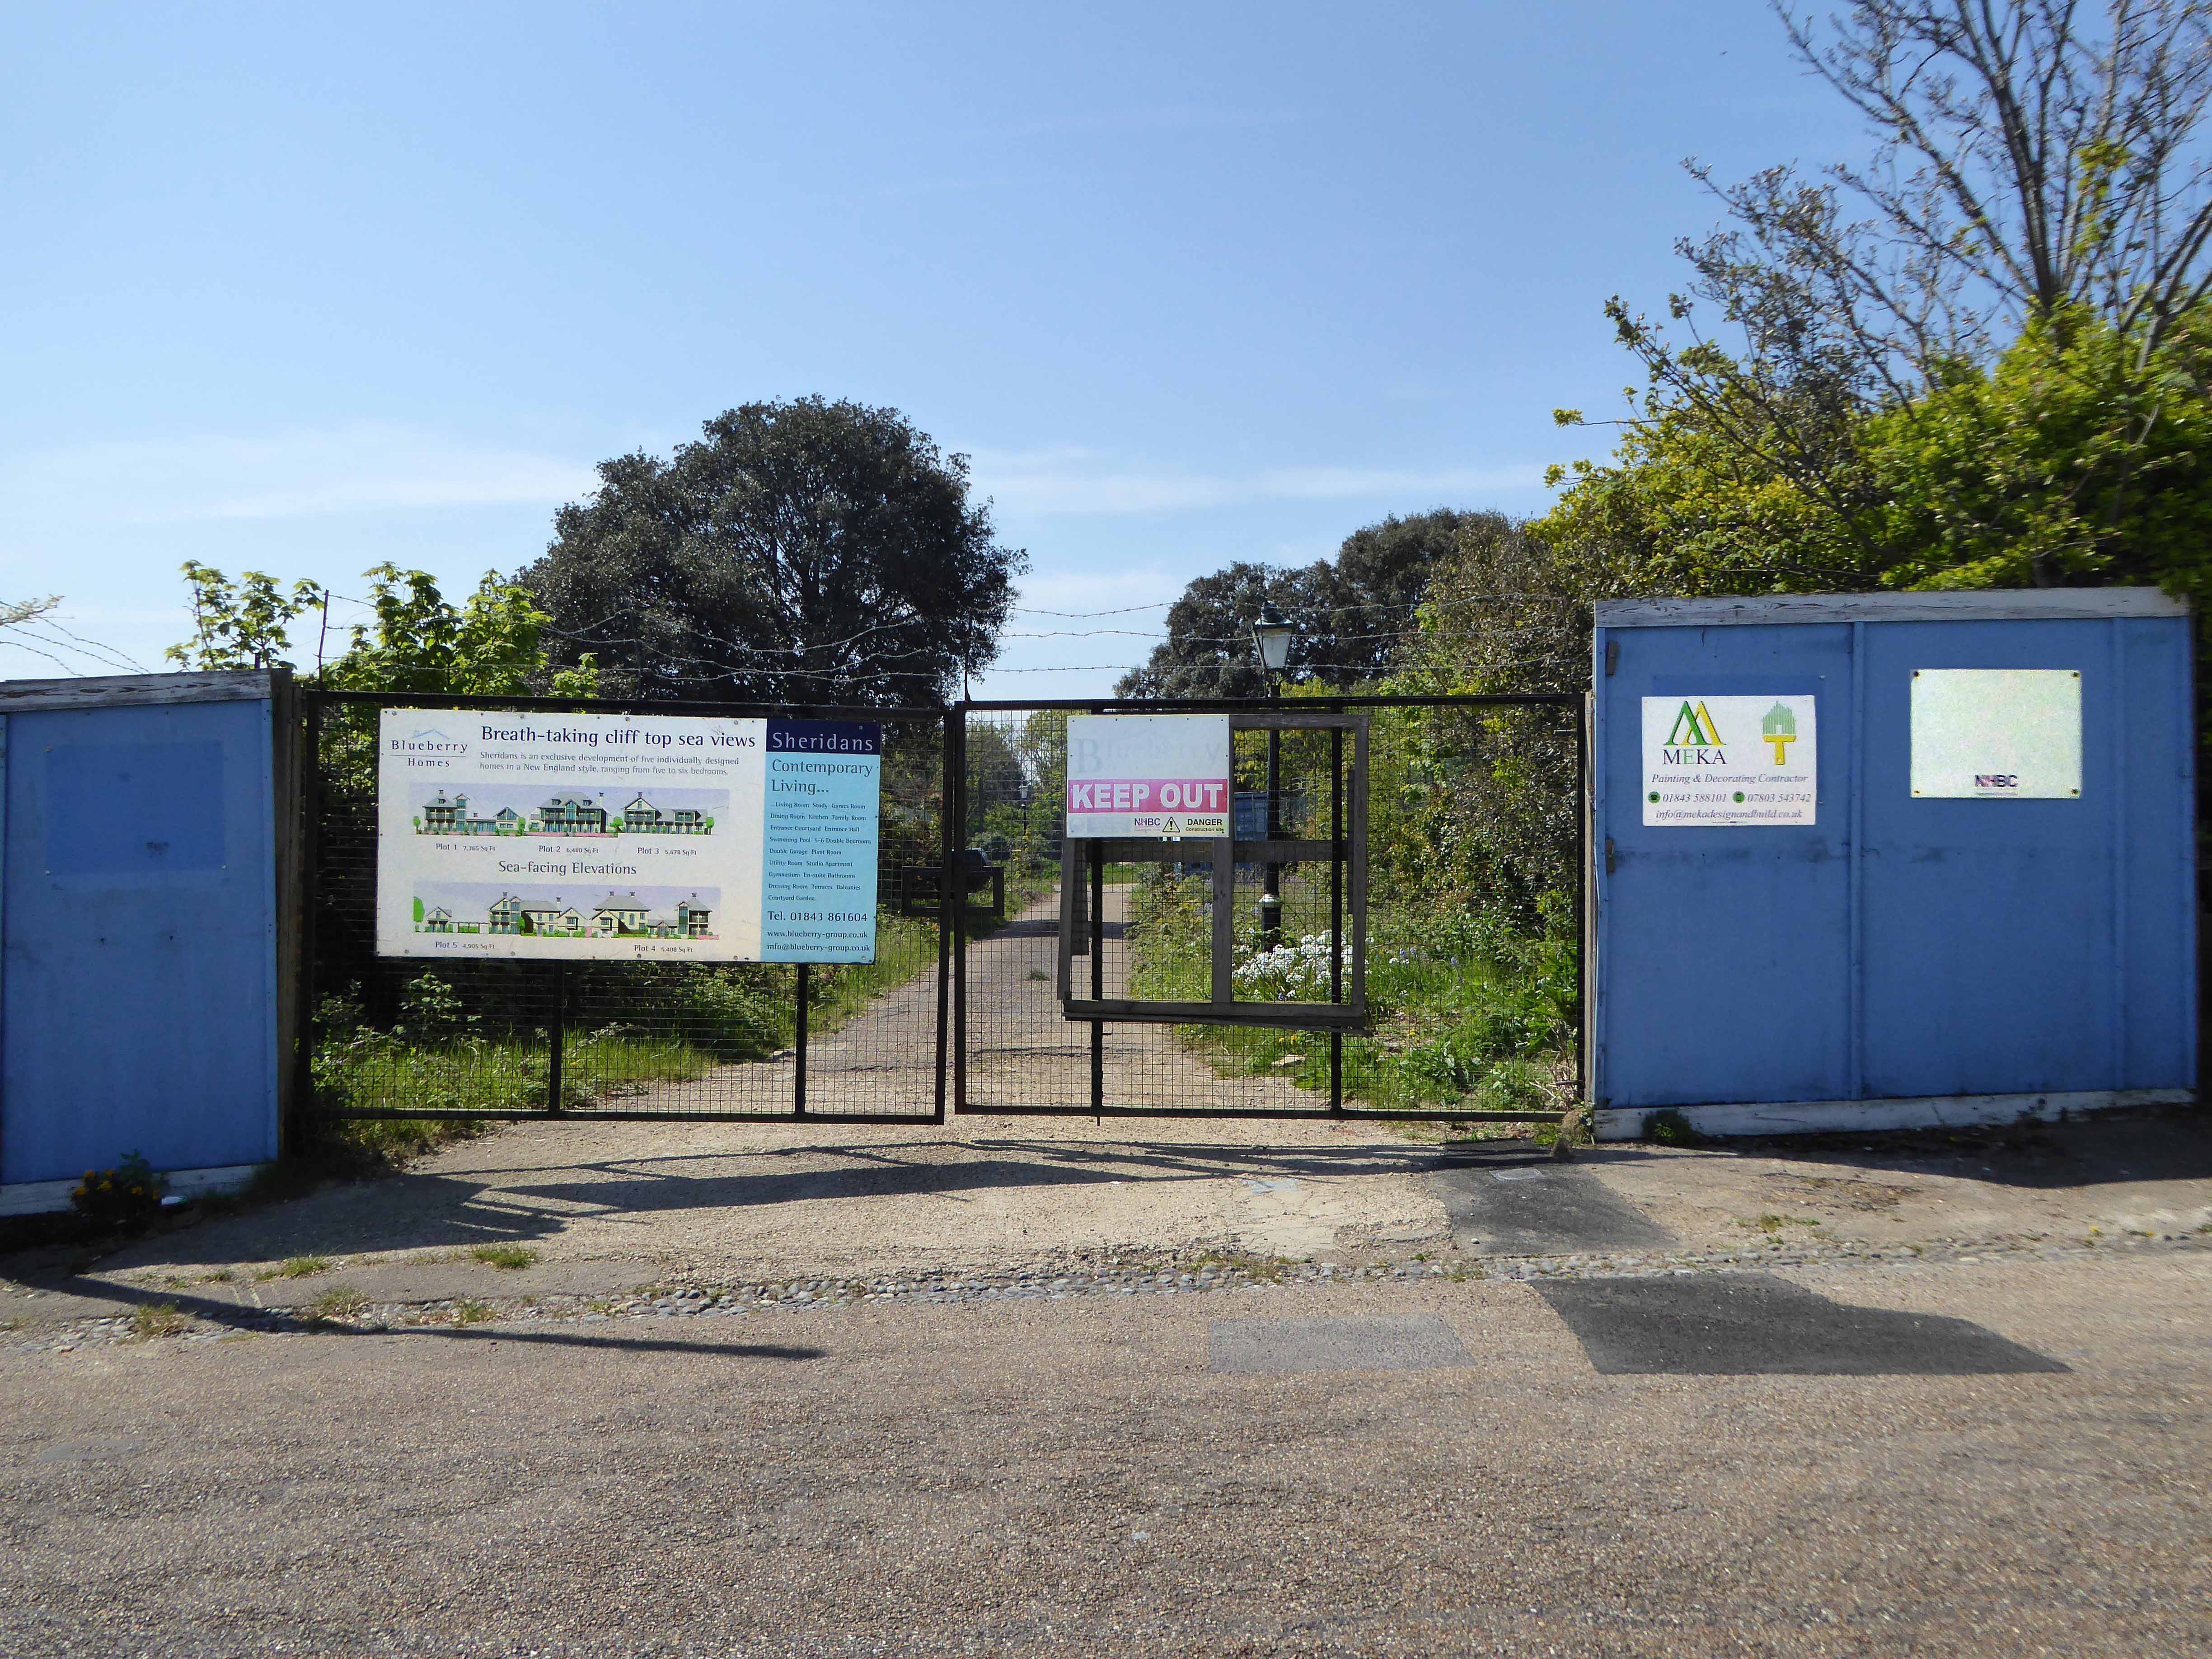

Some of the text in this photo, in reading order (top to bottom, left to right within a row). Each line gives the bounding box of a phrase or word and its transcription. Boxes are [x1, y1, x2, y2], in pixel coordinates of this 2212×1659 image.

[482, 726, 755, 748] Breath-taking cliff top sea views
[772, 732, 873, 751] Sheridans
[392, 740, 468, 753] Blueberry
[408, 758, 450, 767] Homes
[480, 751, 518, 759] Sheridans
[578, 754, 628, 763] development
[657, 755, 702, 765] individually
[705, 757, 739, 766] designed
[1663, 749, 1728, 765] MEKA
[544, 764, 575, 772] England
[578, 764, 599, 773] style,
[653, 766, 665, 774] five
[772, 759, 873, 777] Contemporary
[1651, 773, 1809, 784] Painting & Decorating Contractor
[772, 779, 829, 796] Living...
[1072, 783, 1223, 809] KEEP OUT
[1662, 793, 1727, 803] 01843 588101
[1747, 793, 1812, 803] 07803 543742
[1655, 809, 1803, 820] info@mekadesignandbuild.co.uk
[1134, 818, 1161, 826] NHBC
[498, 861, 636, 876] Sea-facing Elevations
[768, 911, 867, 922] Tel. 01843 861604
[768, 930, 868, 939] www.blueberry-group.co.uk
[767, 943, 870, 952] info@blueberry-group.co.uk
